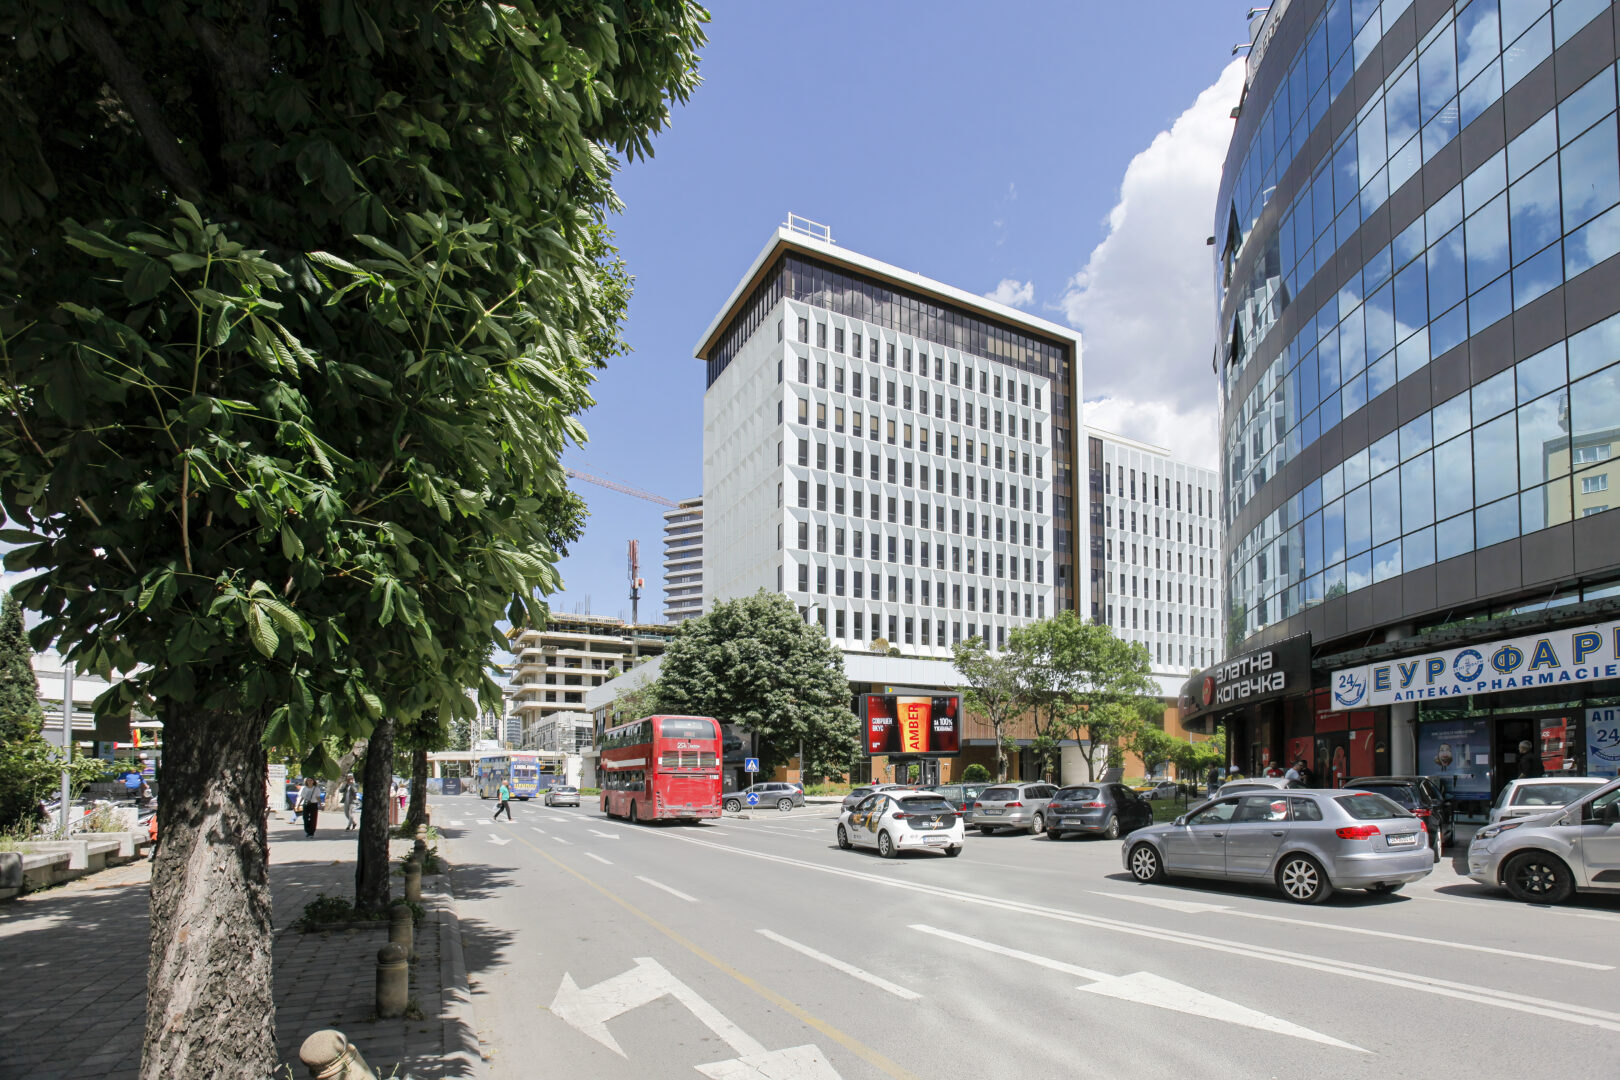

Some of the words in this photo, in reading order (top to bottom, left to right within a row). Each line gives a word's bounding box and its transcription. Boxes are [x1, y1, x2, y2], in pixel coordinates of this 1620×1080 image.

[1374, 626, 1620, 692] ЕУРОФАР
[1339, 672, 1361, 696] 24/7
[1394, 684, 1462, 702] АПТЕКА
[1477, 664, 1617, 692] PHARMACIE
[908, 705, 920, 750] AMBER
[1592, 709, 1620, 722] АП
